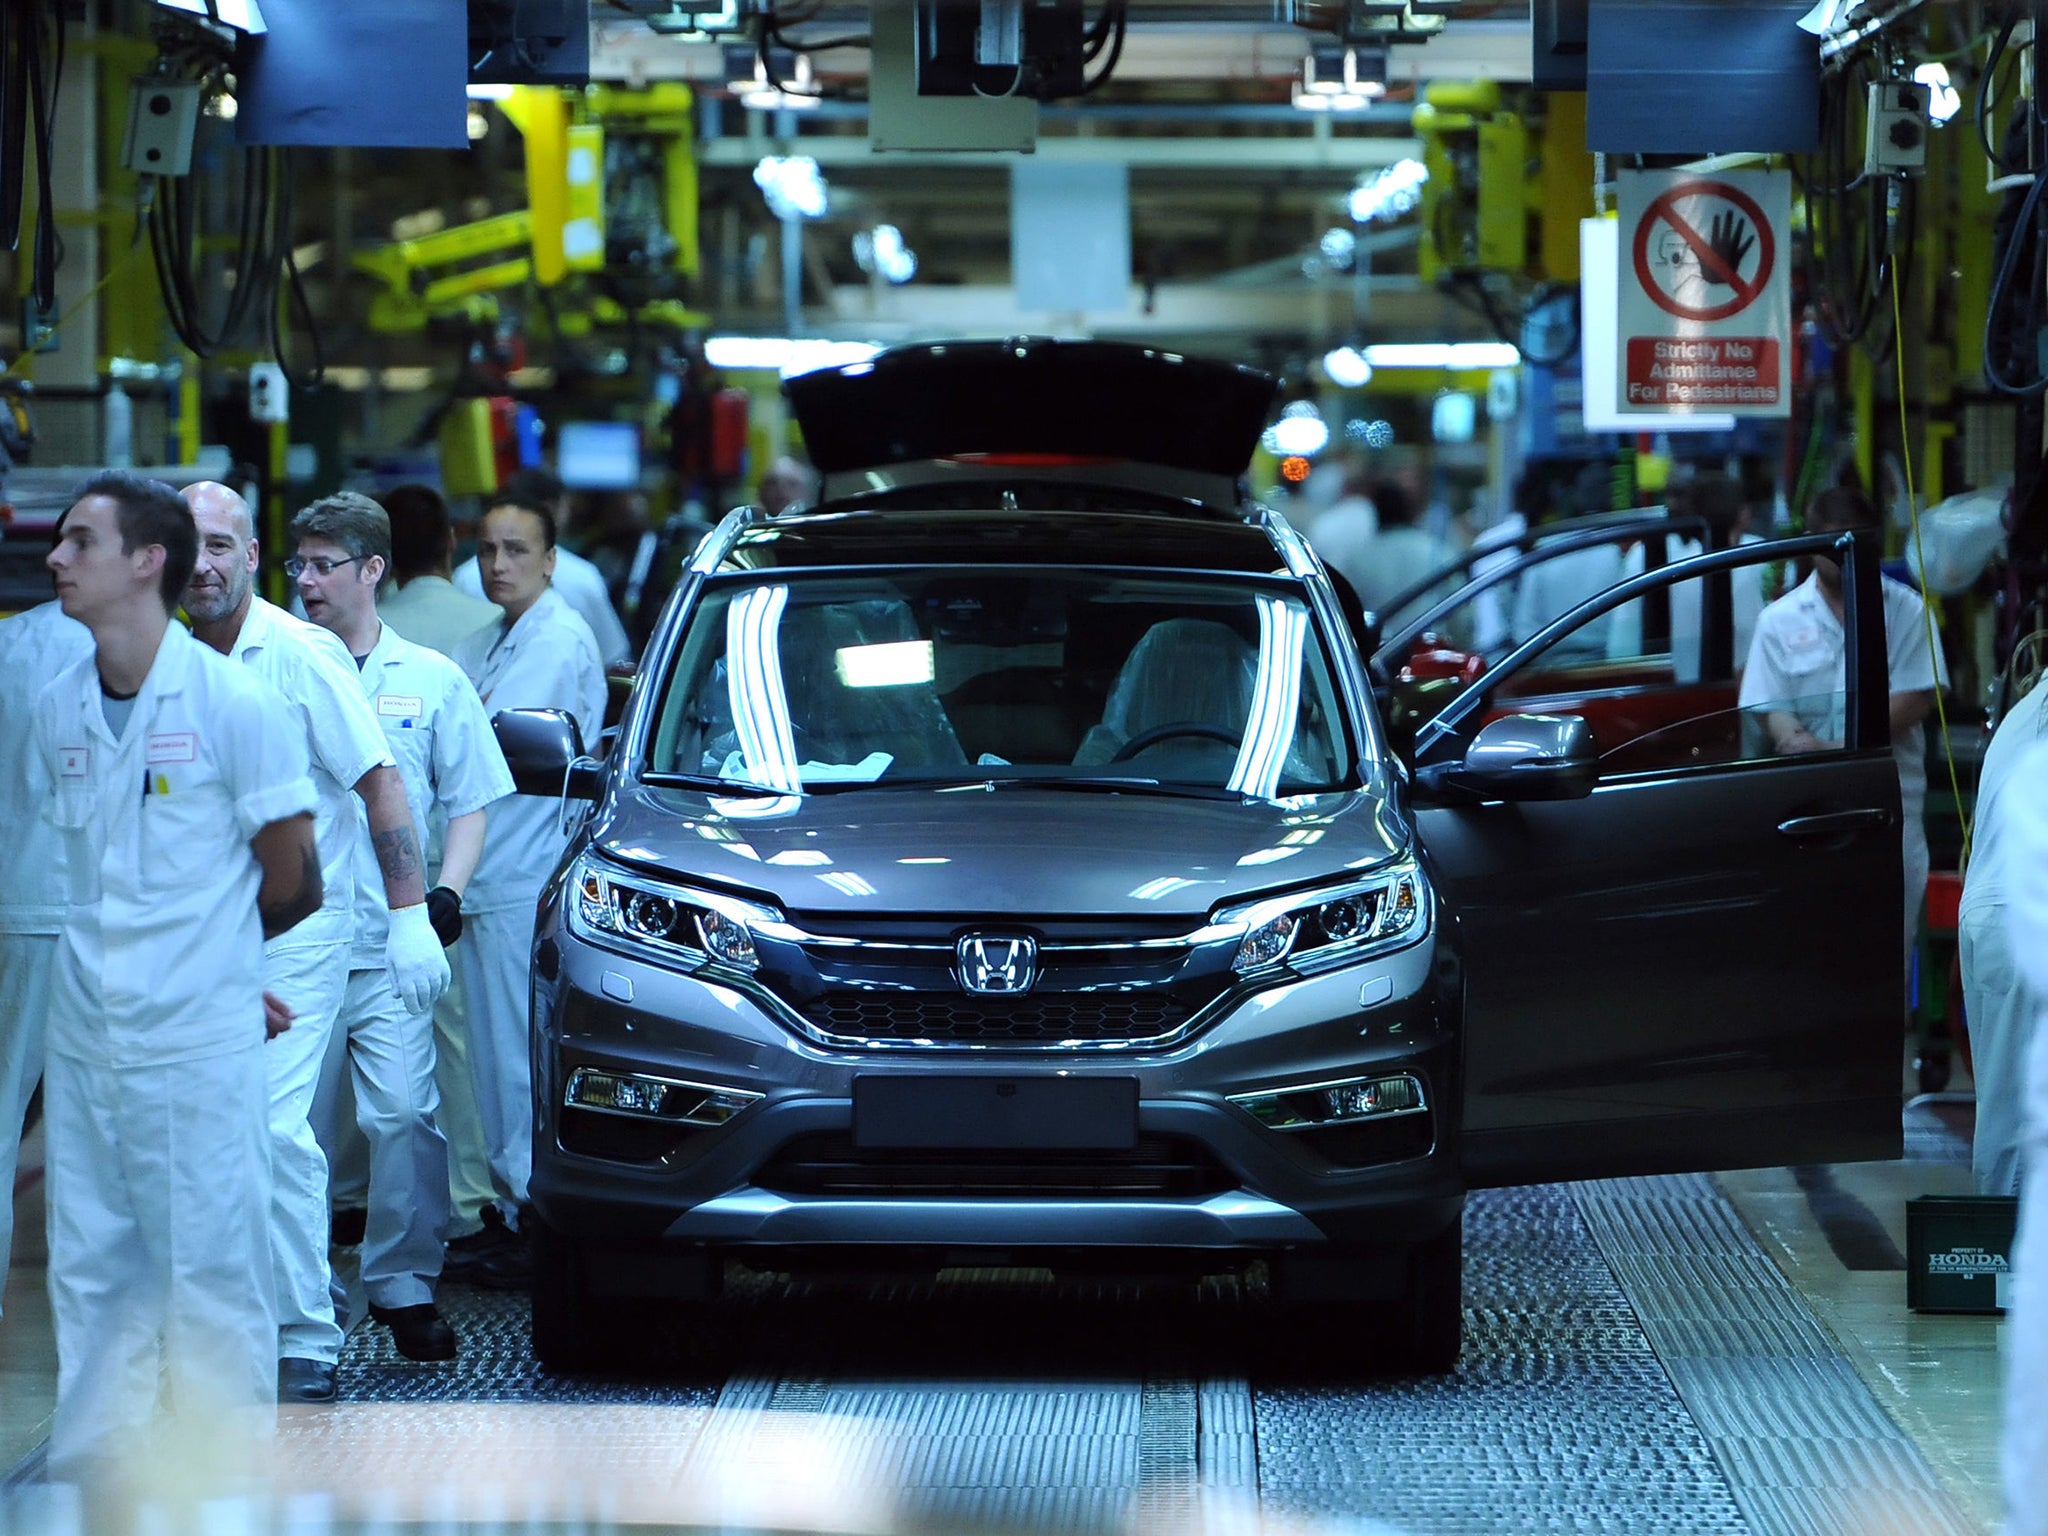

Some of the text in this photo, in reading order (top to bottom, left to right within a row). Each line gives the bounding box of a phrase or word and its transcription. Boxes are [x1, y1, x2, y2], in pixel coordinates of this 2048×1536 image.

[1654, 341, 1753, 361] Strictly No
[1650, 362, 1756, 379] Admittance
[1629, 382, 1777, 400] For Pedestrians
[1928, 1254, 2009, 1266] HONDA
